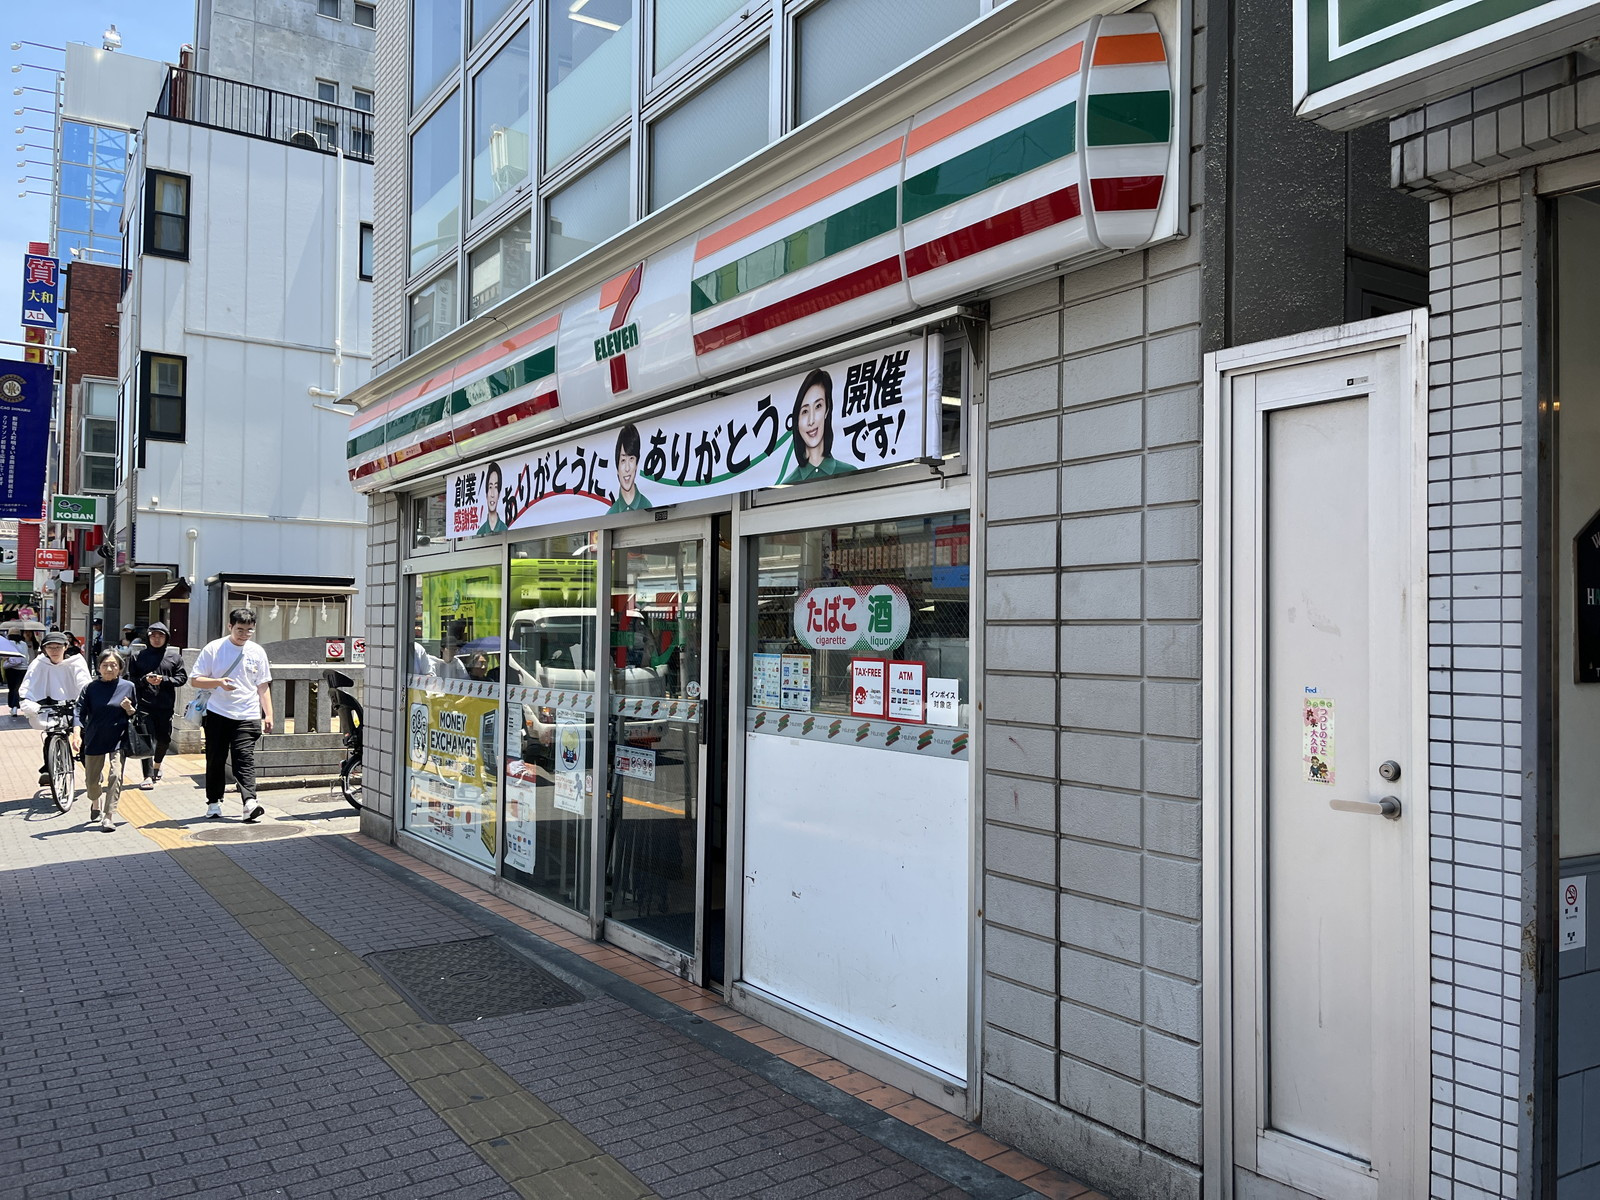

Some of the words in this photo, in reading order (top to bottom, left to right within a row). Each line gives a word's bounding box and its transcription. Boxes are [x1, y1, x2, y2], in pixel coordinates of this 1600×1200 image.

[27, 258, 56, 287] 質
[28, 290, 53, 303] 大和
[27, 311, 44, 320] 入口
[841, 349, 911, 418] 開催
[454, 471, 485, 508] 創業!
[502, 446, 616, 529] ありがとうに、
[56, 512, 94, 520] KOBAN
[453, 505, 484, 532] 感謝祭!
[38, 550, 53, 559] ria
[806, 594, 857, 633] たばこ
[867, 594, 893, 633] 酒
[815, 636, 847, 647] cigarette
[870, 635, 893, 646] liquor
[898, 671, 914, 680] ATM
[929, 690, 956, 700] インボイス
[933, 700, 952, 710] 対象店
[439, 710, 468, 733] MONEY
[1319, 708, 1328, 756] つつじのさと
[430, 730, 477, 760] EXCHANGE
[1309, 728, 1319, 755] 大久保
